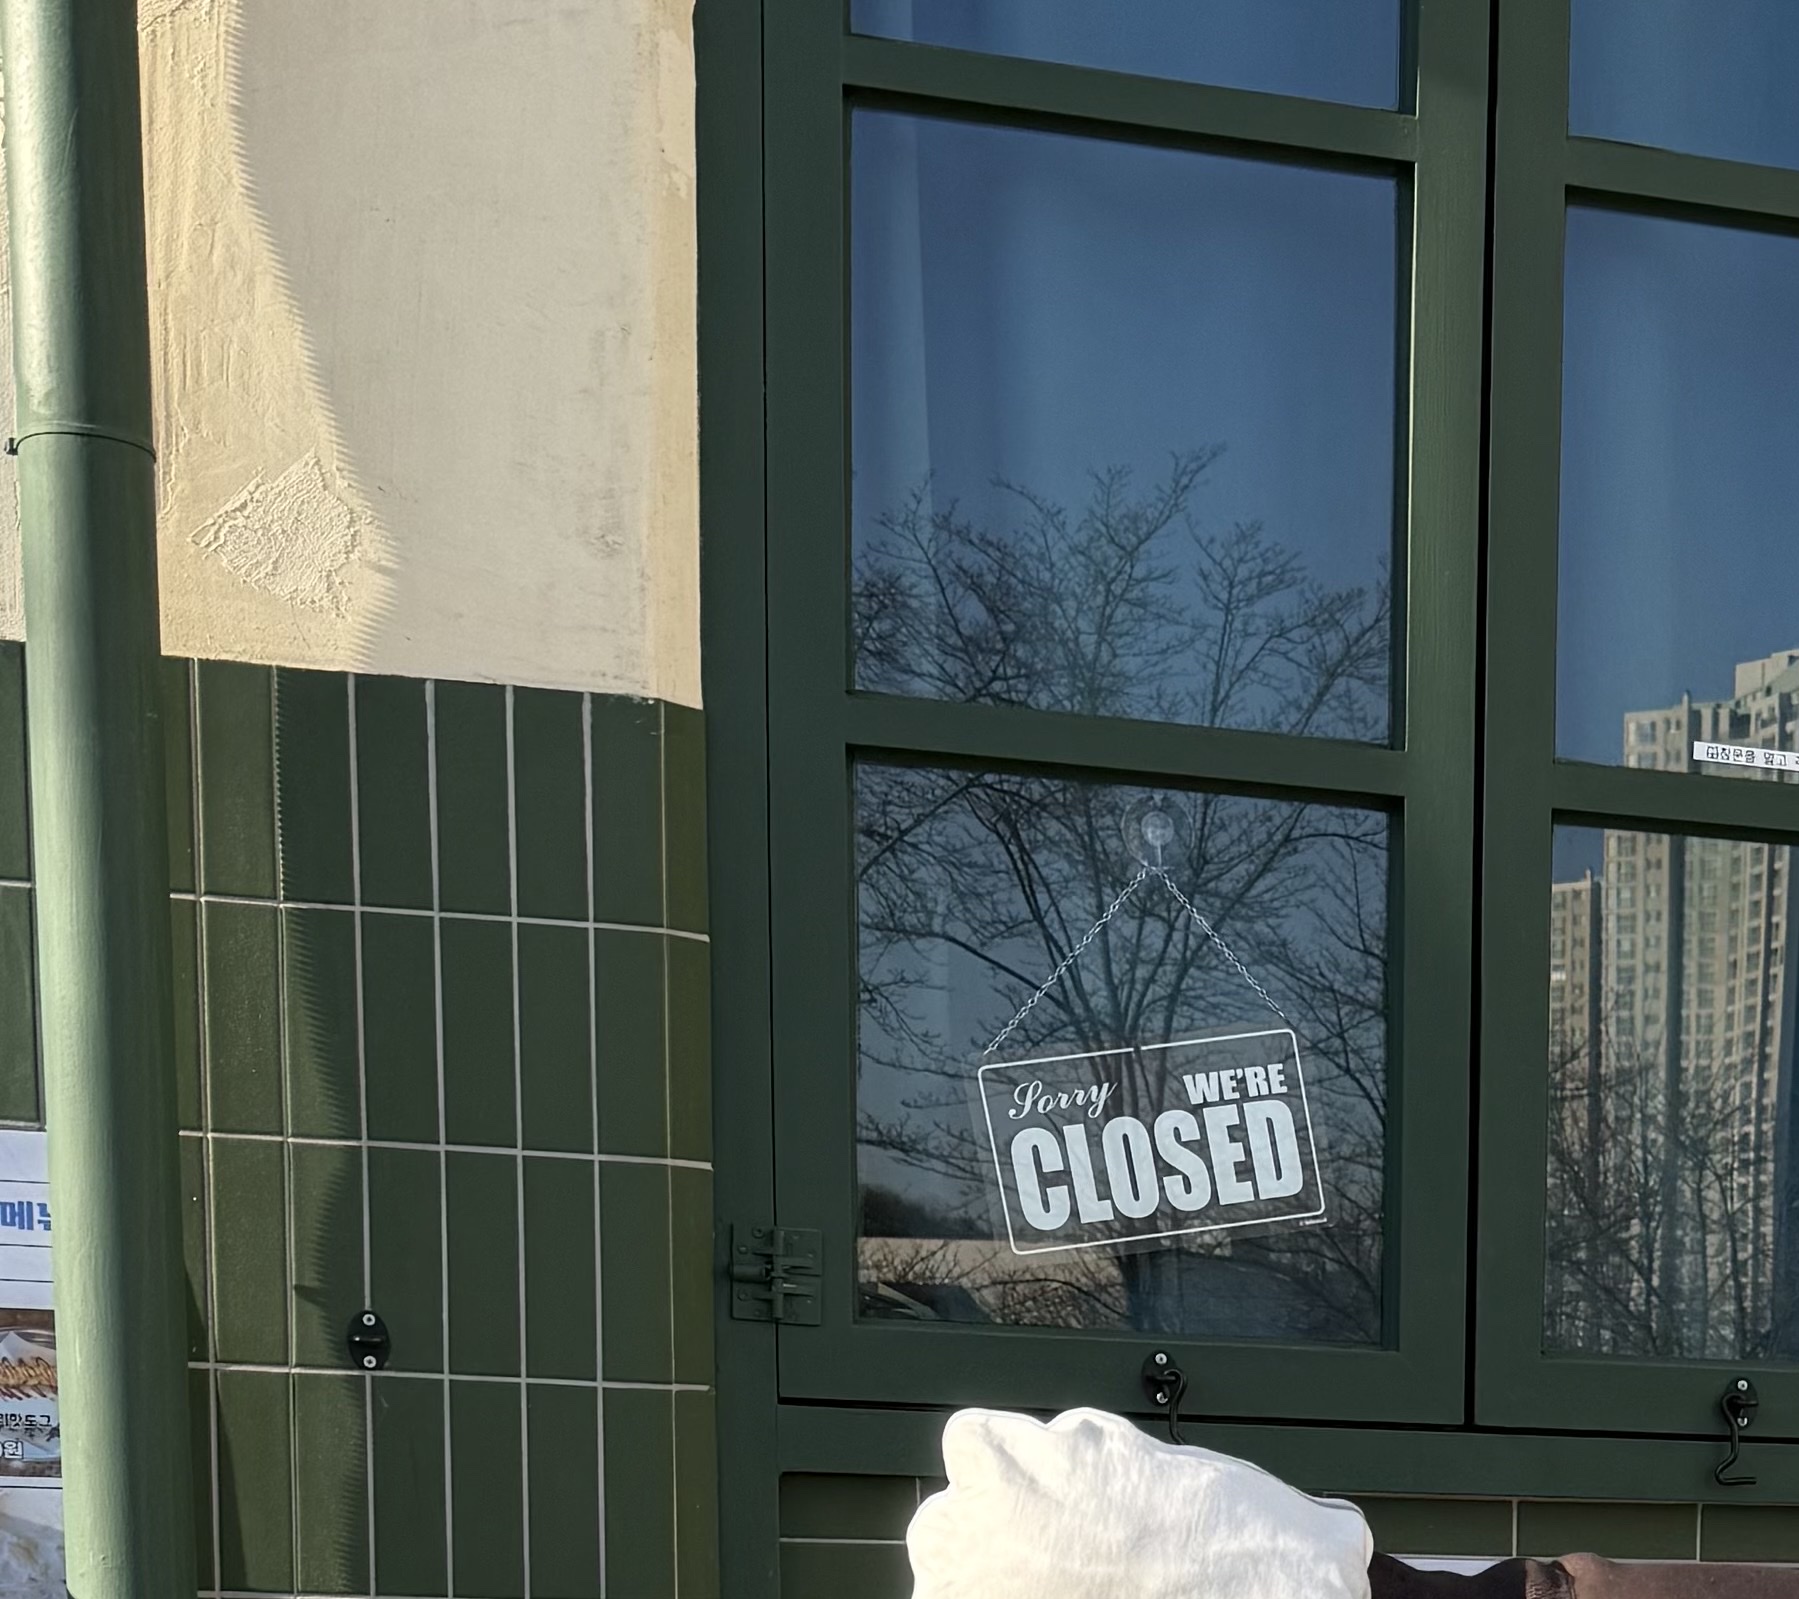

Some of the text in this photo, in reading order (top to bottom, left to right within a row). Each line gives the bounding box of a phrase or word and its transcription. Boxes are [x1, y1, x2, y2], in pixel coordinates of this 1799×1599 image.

[1007, 1063, 1288, 1120] Sorry WE'RE
[1010, 1099, 1304, 1231] CLOSED
